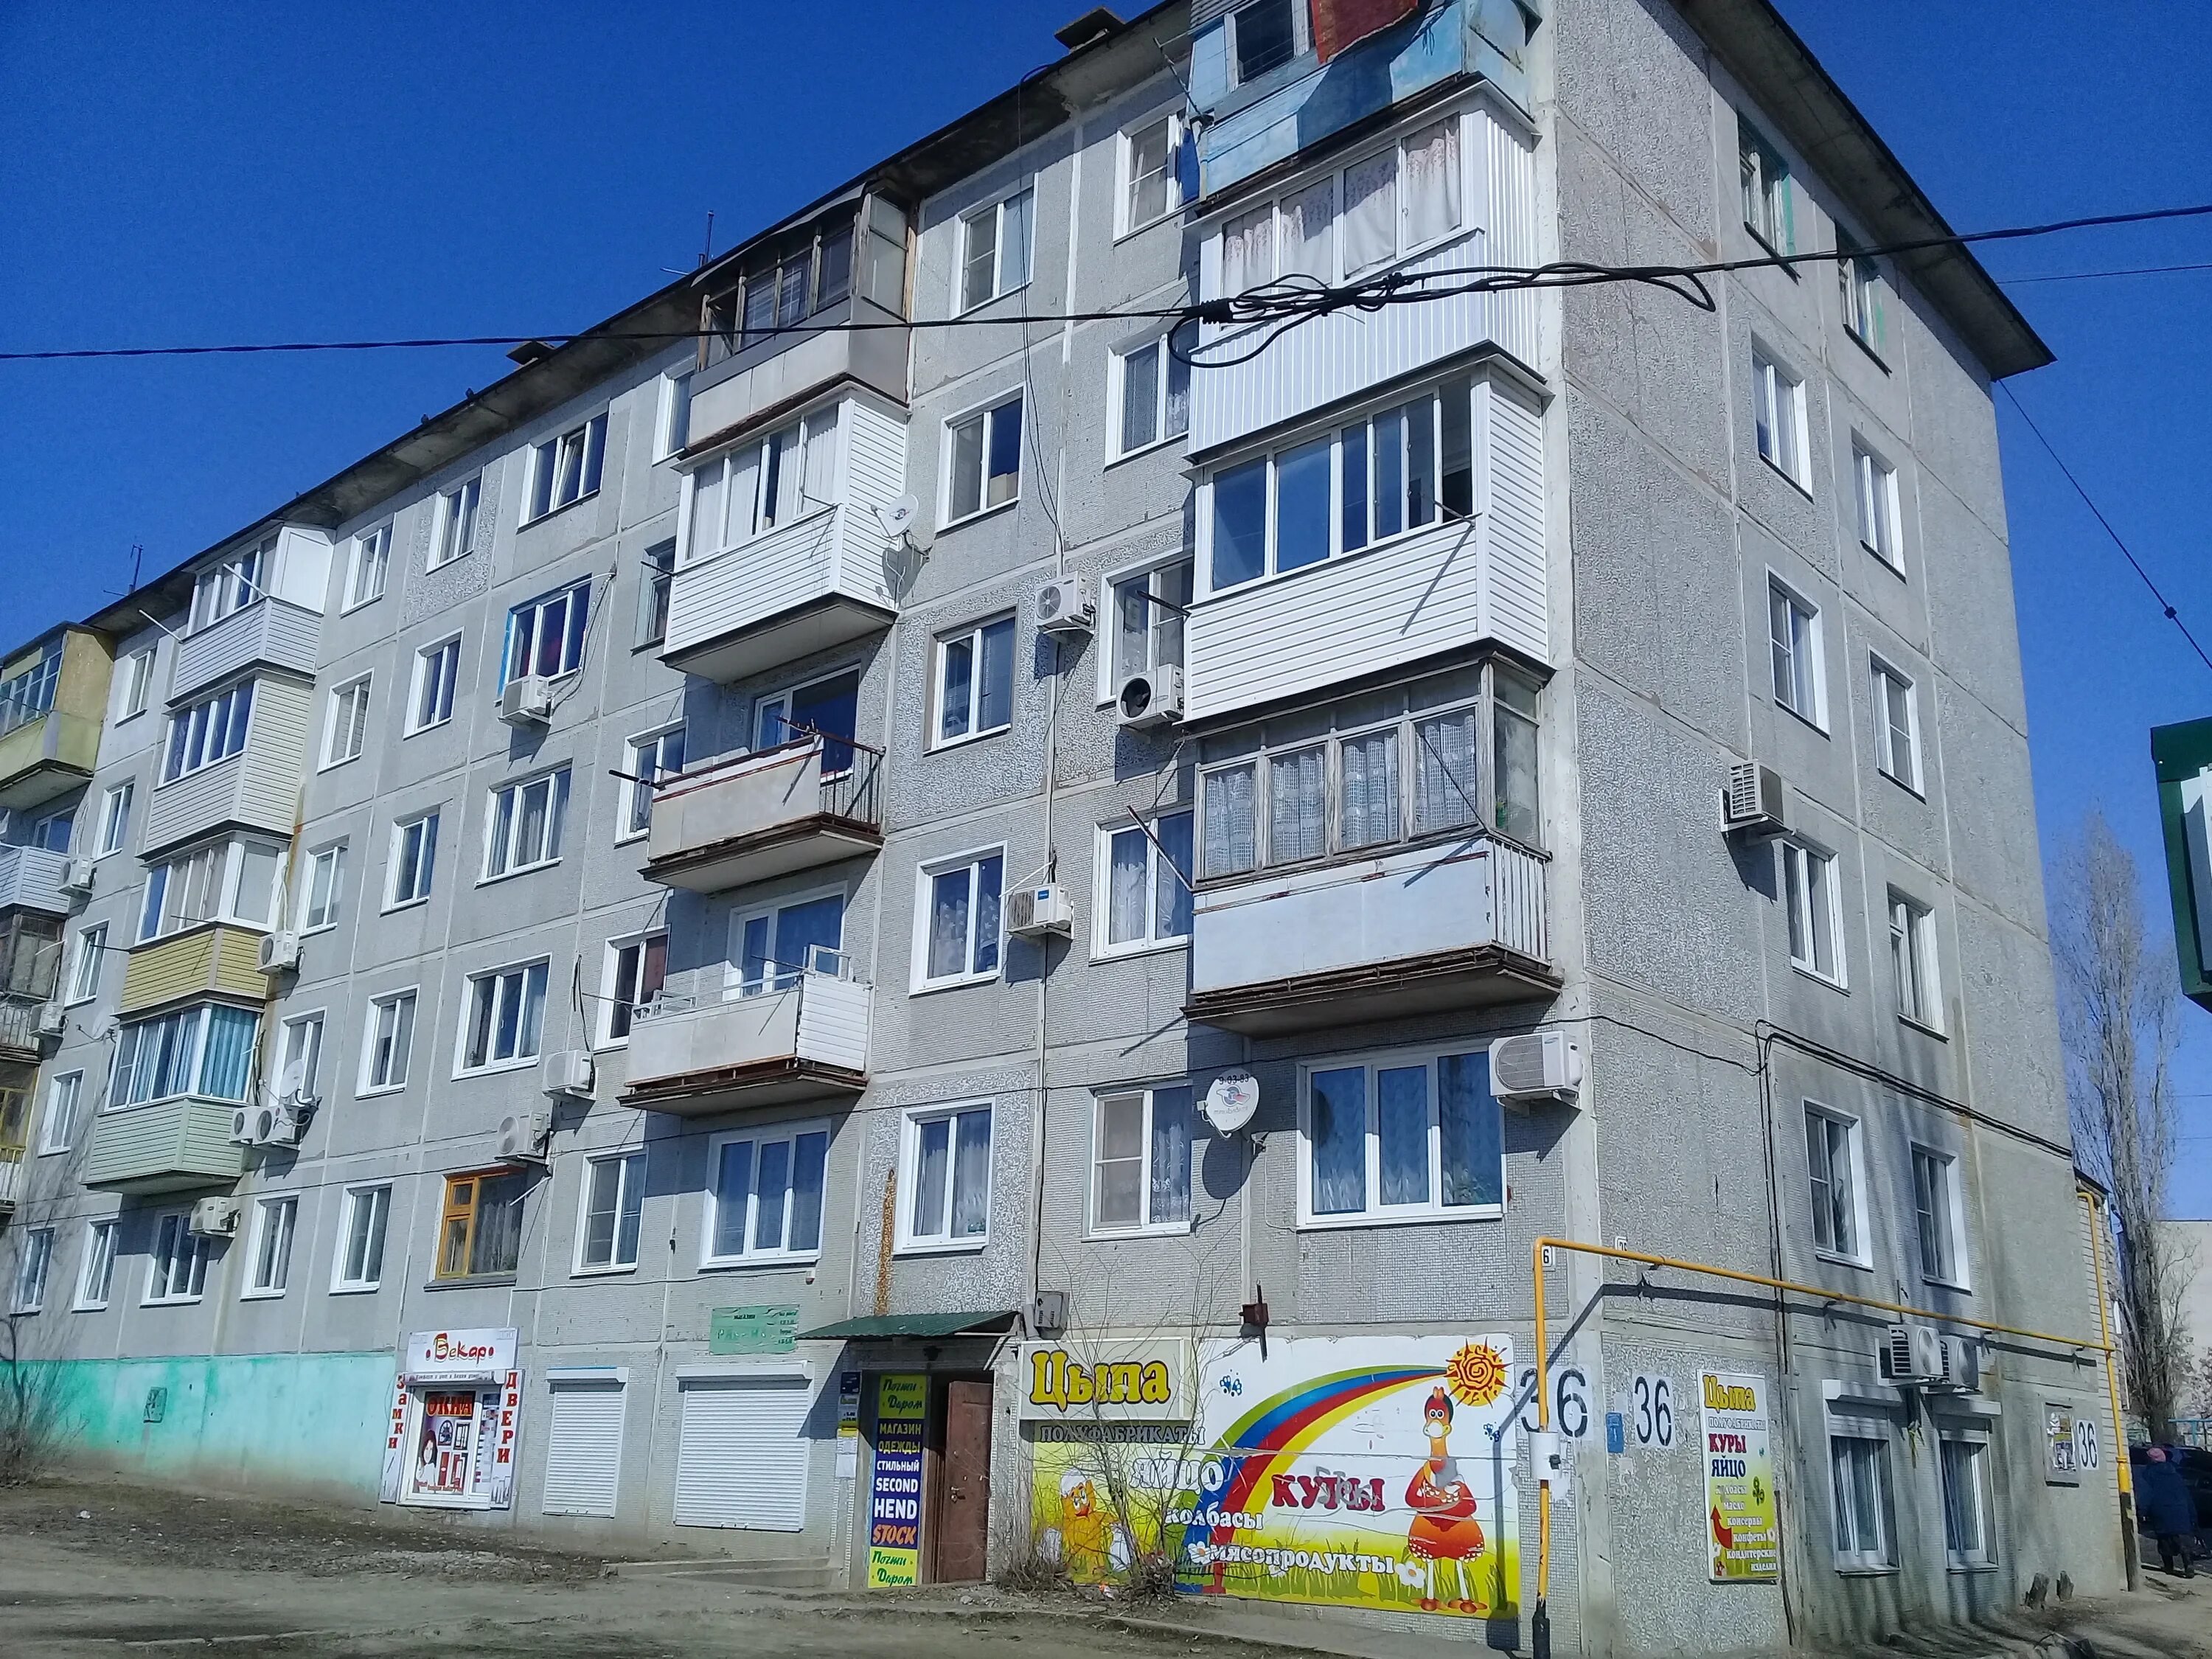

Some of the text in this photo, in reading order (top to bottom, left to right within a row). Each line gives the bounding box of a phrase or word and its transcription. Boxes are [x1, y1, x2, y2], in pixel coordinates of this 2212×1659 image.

[1029, 1350, 1172, 1413] Цыпа
[1703, 1374, 1756, 1413] Цыпа
[496, 1372, 518, 1464] ДВЕРИ
[1635, 1376, 1672, 1447] 36
[879, 1423, 922, 1435] МАГАЗИН
[1040, 1425, 1206, 1445] ПОЛУФАБРИКАТЫ
[878, 1441, 921, 1455] ОДЕЖДЫ
[1708, 1433, 1747, 1453] КУРЫ
[2079, 1422, 2097, 1468] 36
[877, 1459, 919, 1472] СТИЛЬНЫЙ
[1129, 1451, 1224, 1495] ЯЙЦО
[1711, 1455, 1746, 1479] ЯЙЦО
[875, 1477, 919, 1493] SECOND
[874, 1498, 918, 1520] HEND
[872, 1524, 917, 1545] STOCK
[1210, 1544, 1396, 1574] мясопродукты
